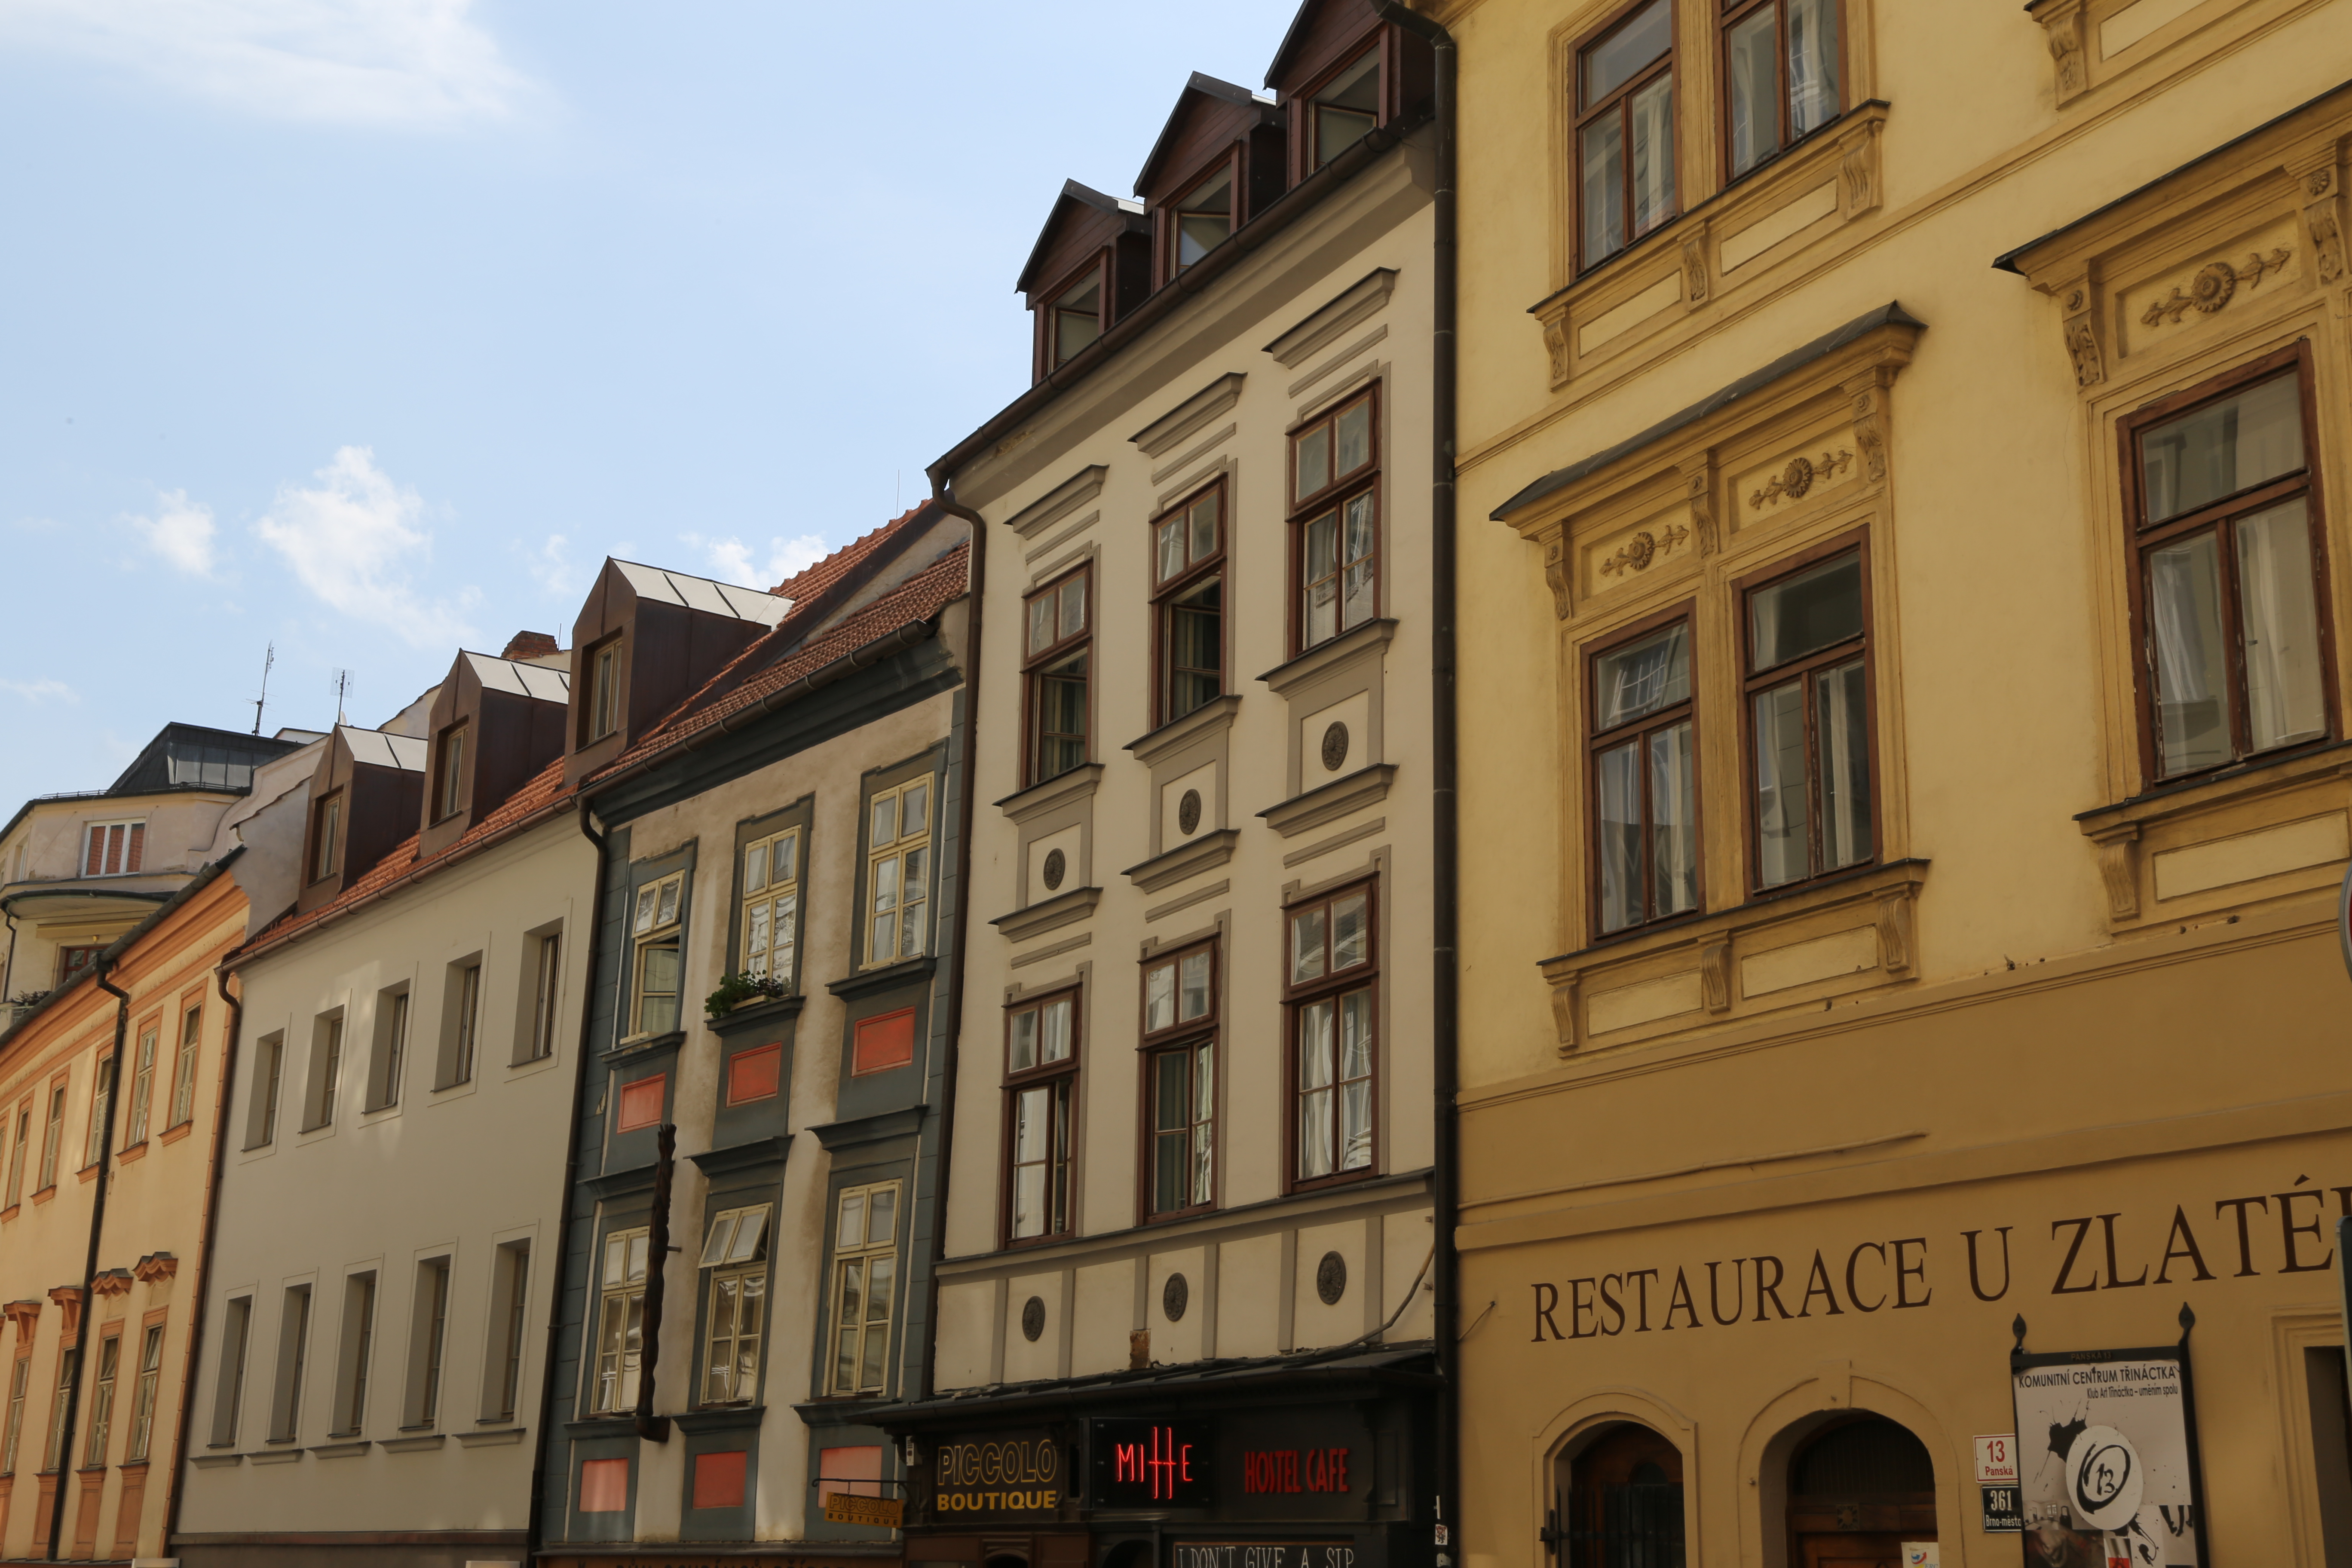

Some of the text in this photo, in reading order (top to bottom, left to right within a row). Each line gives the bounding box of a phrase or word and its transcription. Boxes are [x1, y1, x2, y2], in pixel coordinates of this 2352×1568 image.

[1531, 1237, 1932, 1342] RESTAURACE
[1960, 1226, 2014, 1302] U
[2104, 1351, 2112, 1360] 13
[2018, 1364, 2176, 1388] KOMUNITNÍ CENTRUM TŘINÁCTKA
[2087, 1388, 2098, 1399] Klub
[2108, 1385, 2133, 1397] Třináctka
[2139, 1383, 2162, 1396] uměním
[2163, 1383, 2178, 1397] spolu
[937, 1439, 1057, 1485] PICCOLO
[1987, 1440, 2005, 1463] 13
[1245, 1448, 1350, 1493] HOSTEL CAFE
[1985, 1465, 2013, 1476] Panská
[2096, 1462, 2115, 1496] 13
[829, 1494, 899, 1515] PICCOLO
[937, 1490, 1057, 1511] BOUTIQUE
[1990, 1490, 2012, 1511] 361
[828, 1513, 898, 1525] BOUTIQUE
[1985, 1515, 2021, 1527] Brno-město
